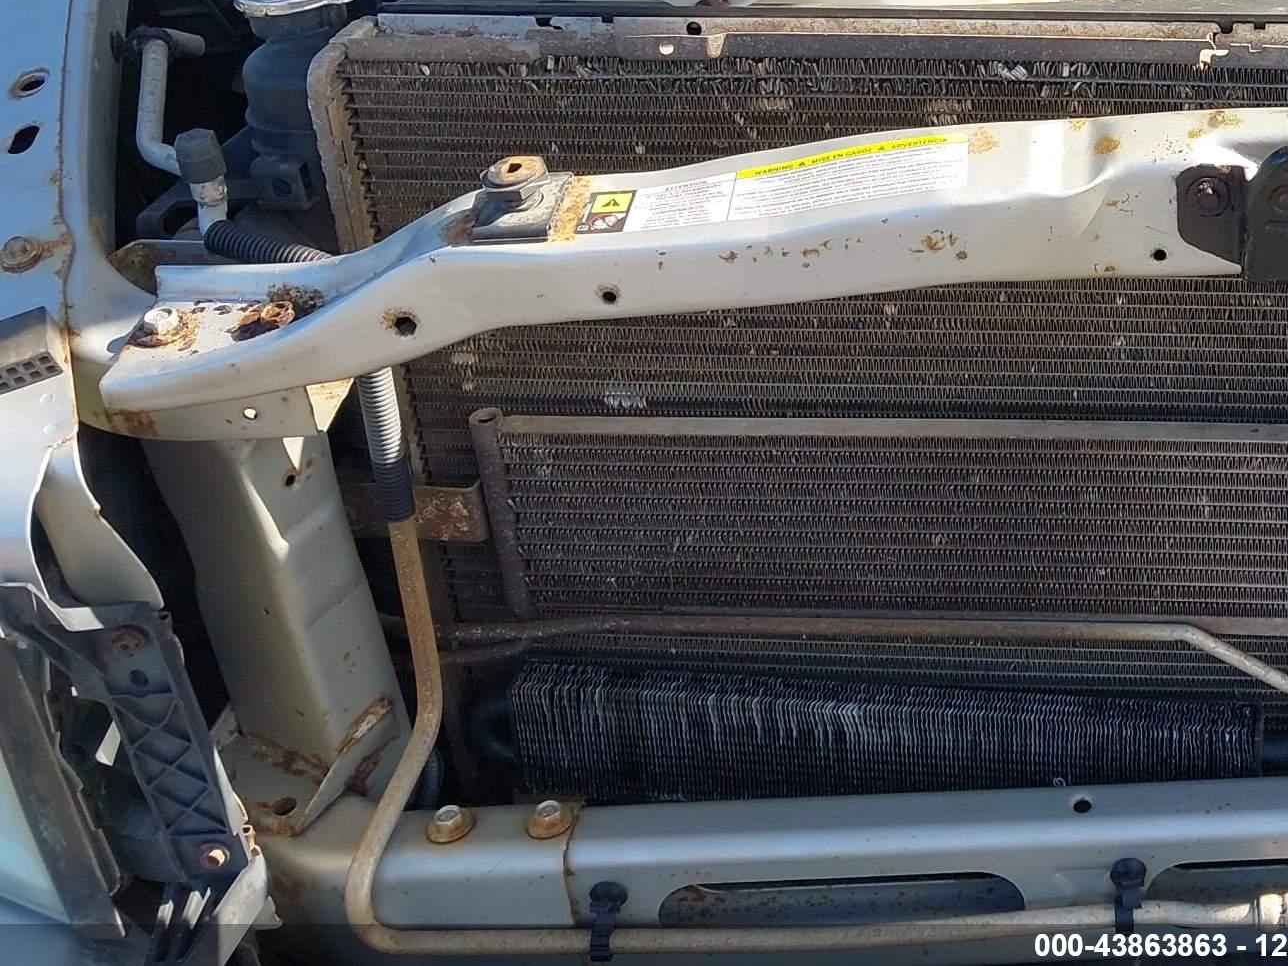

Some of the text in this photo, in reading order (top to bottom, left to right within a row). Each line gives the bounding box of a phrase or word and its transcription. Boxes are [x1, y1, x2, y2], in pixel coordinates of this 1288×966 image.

[754, 138, 948, 176] WARNING MISE EN GARDE ADVERTENCIA
